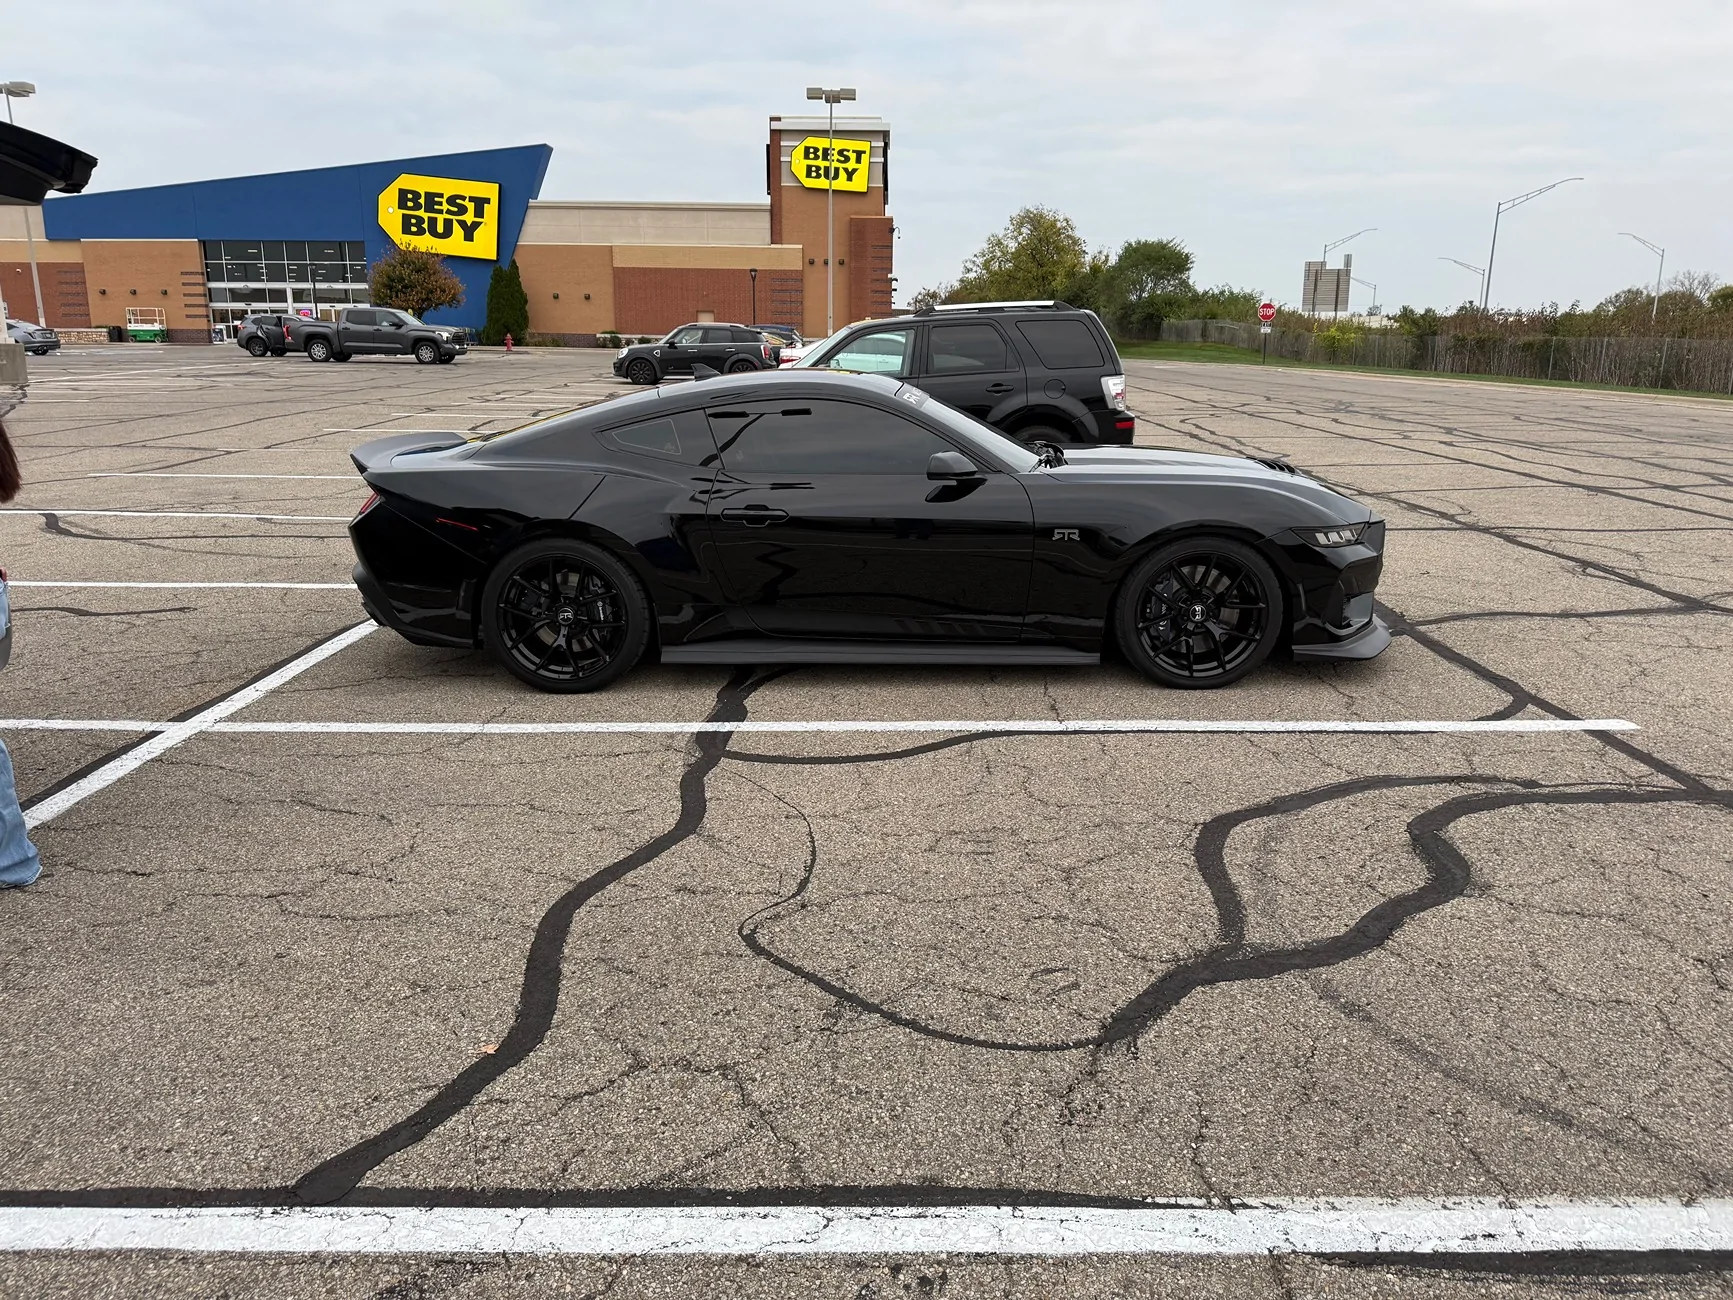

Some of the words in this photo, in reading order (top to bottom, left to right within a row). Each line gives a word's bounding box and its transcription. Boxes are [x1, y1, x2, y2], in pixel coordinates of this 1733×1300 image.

[803, 146, 866, 165] BEST
[805, 164, 860, 182] BUY
[398, 188, 491, 219] BEST
[402, 213, 484, 242] BUY
[1260, 308, 1275, 316] STOP
